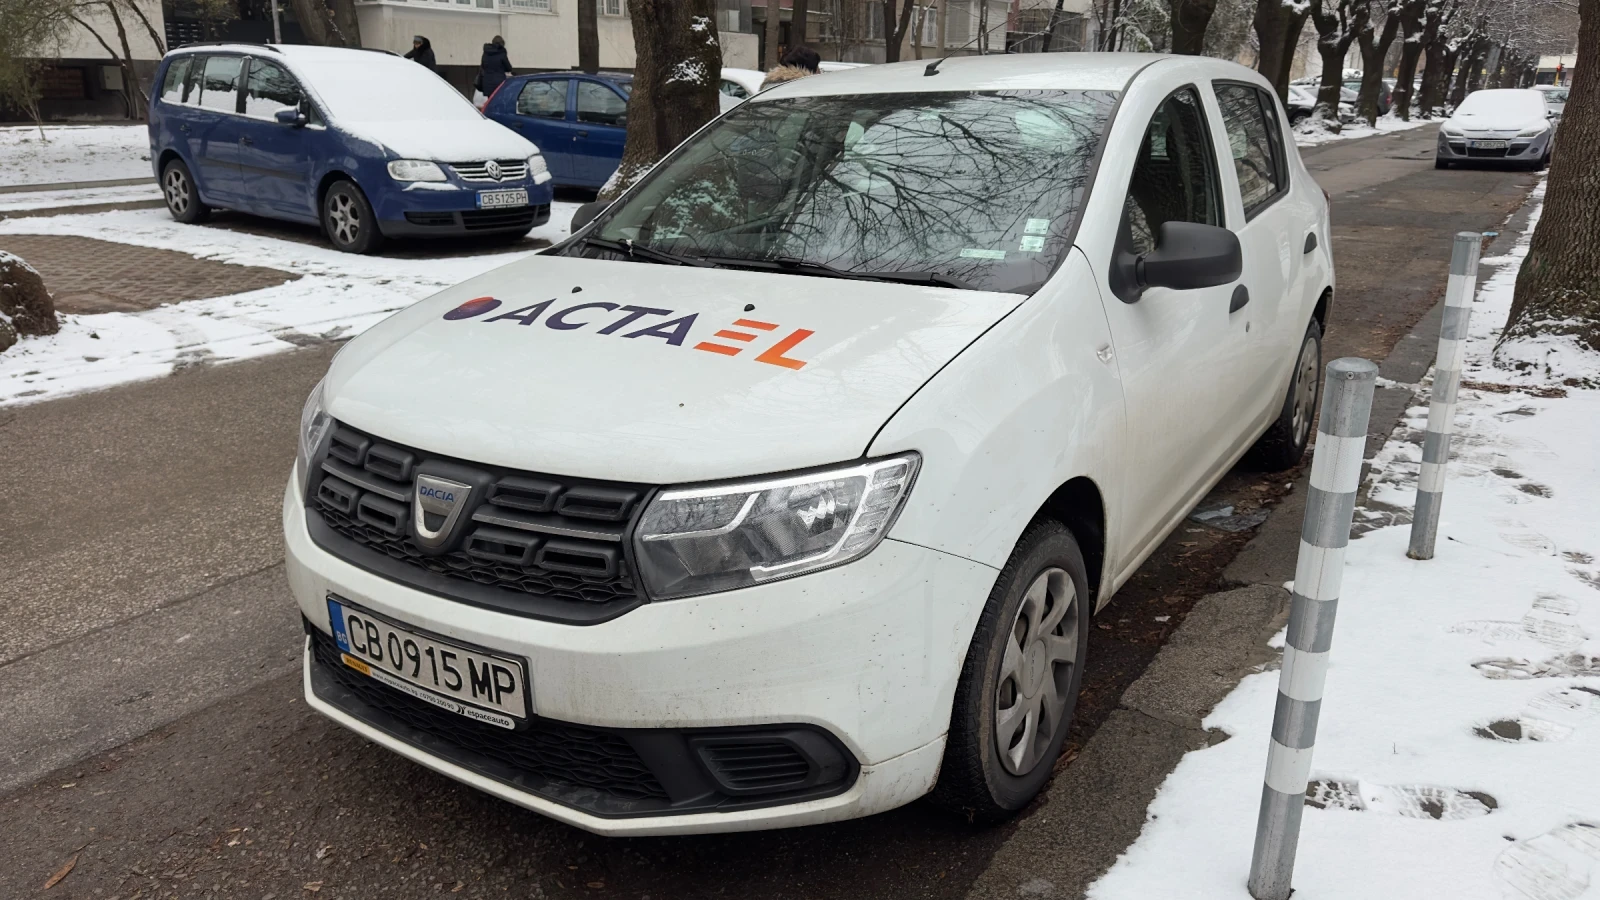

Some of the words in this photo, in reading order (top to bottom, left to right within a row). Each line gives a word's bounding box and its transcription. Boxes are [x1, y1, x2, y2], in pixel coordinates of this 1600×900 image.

[495, 193, 515, 204] 5125
[420, 485, 455, 503] DACIA
[336, 630, 348, 645] BG
[347, 614, 384, 662] CB
[387, 631, 463, 692] 0915
[467, 657, 516, 705] MP
[467, 709, 510, 726] espaceauto
